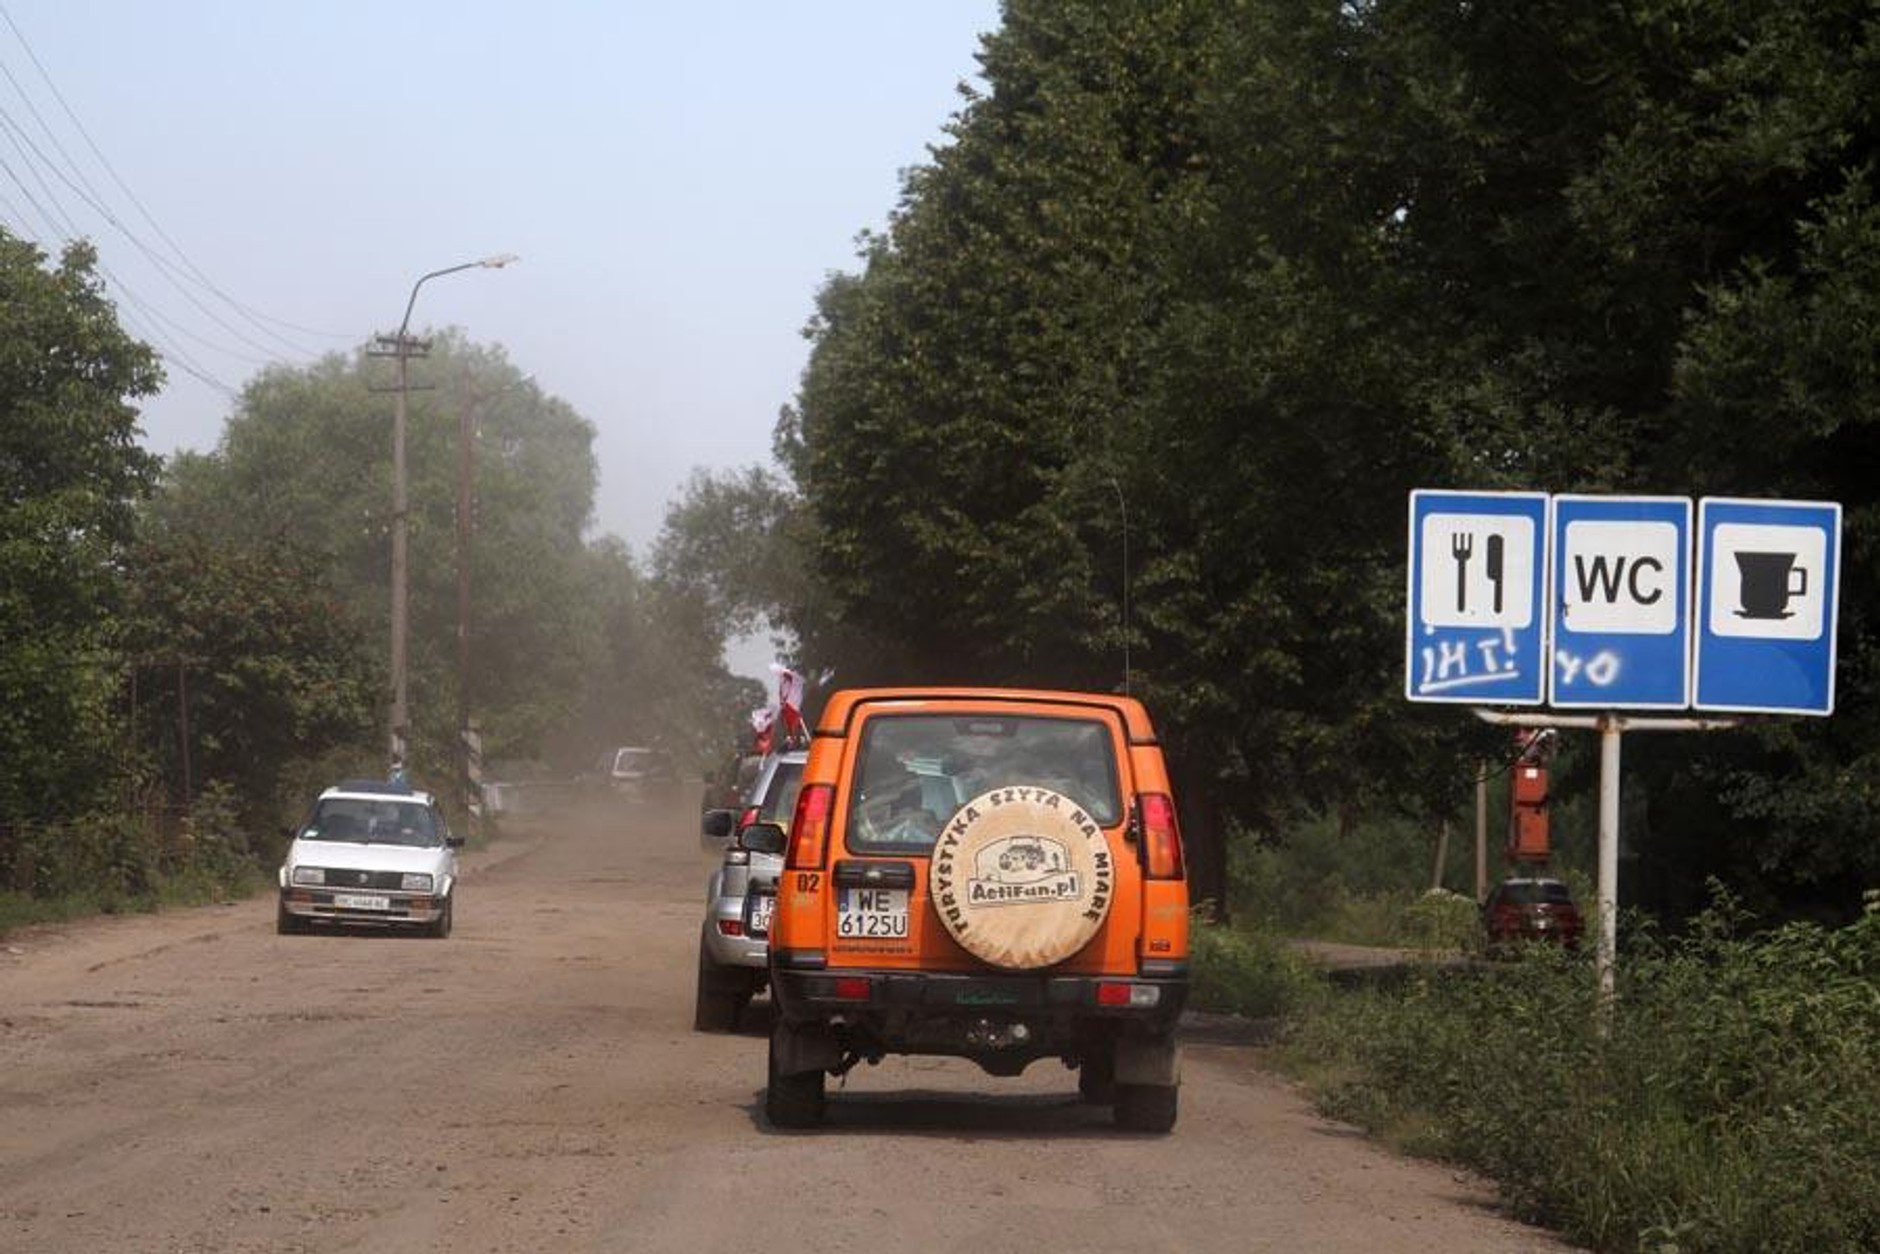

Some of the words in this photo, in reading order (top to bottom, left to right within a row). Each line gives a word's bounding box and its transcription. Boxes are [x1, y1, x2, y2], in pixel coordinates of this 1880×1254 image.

[1574, 554, 1664, 606] WC
[938, 806, 981, 934] TURYSTYKA
[990, 788, 1061, 810] SZYTA
[1070, 810, 1096, 840] NA
[858, 890, 890, 912] WE
[841, 914, 906, 935] 6125U
